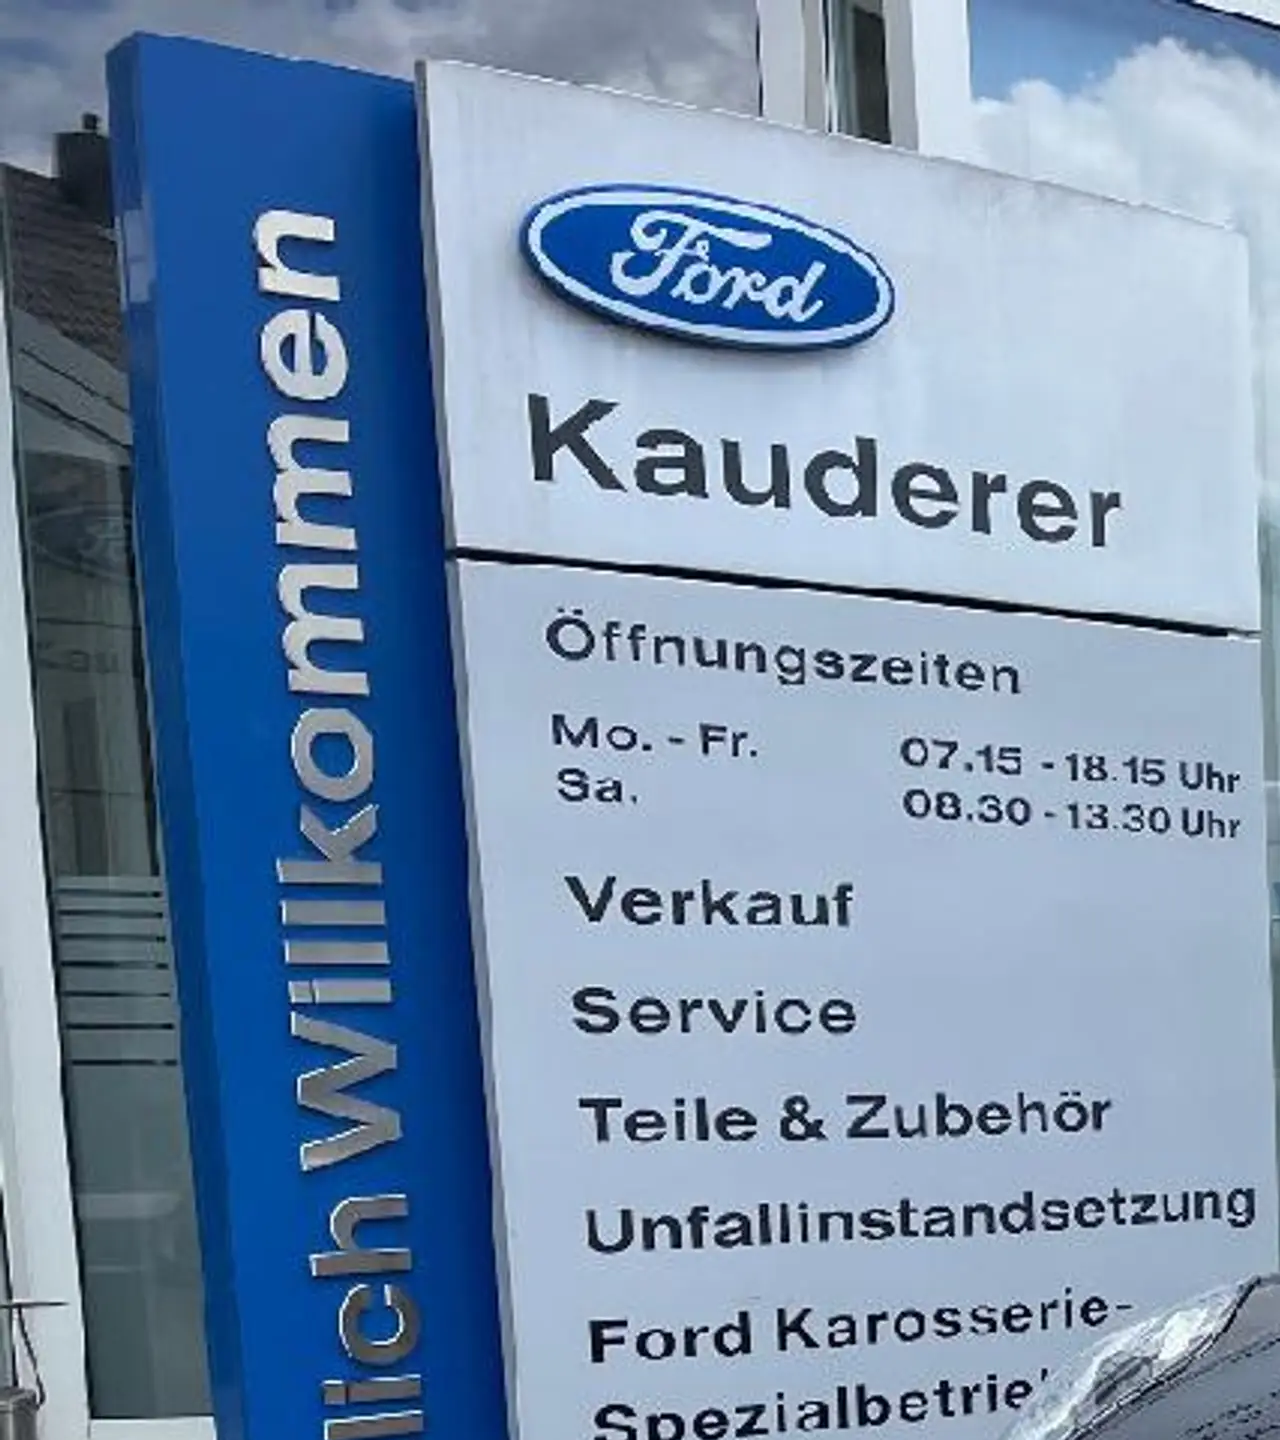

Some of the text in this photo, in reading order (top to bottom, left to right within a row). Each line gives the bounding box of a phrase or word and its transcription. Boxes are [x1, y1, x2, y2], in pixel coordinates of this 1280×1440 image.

[610, 207, 824, 325] Ford
[526, 393, 1123, 548] Kauderer
[545, 606, 1022, 696] Öffnungszeiten
[253, 208, 403, 1172] Willkommen
[551, 713, 653, 752] Mo.
[698, 722, 758, 758] Fr.
[899, 736, 1022, 776] 07.15
[1178, 760, 1241, 794] Uhr
[556, 767, 638, 805] Sa.
[902, 788, 1033, 827] 08.30
[1181, 806, 1241, 839] Uhr
[563, 875, 854, 928] Verkauf
[571, 986, 857, 1036] Service
[577, 1090, 1113, 1144] Teile & Zubehör
[585, 1187, 1256, 1255] Unfallinstandsetzung
[587, 1287, 1135, 1364] Ford Karosserie-
